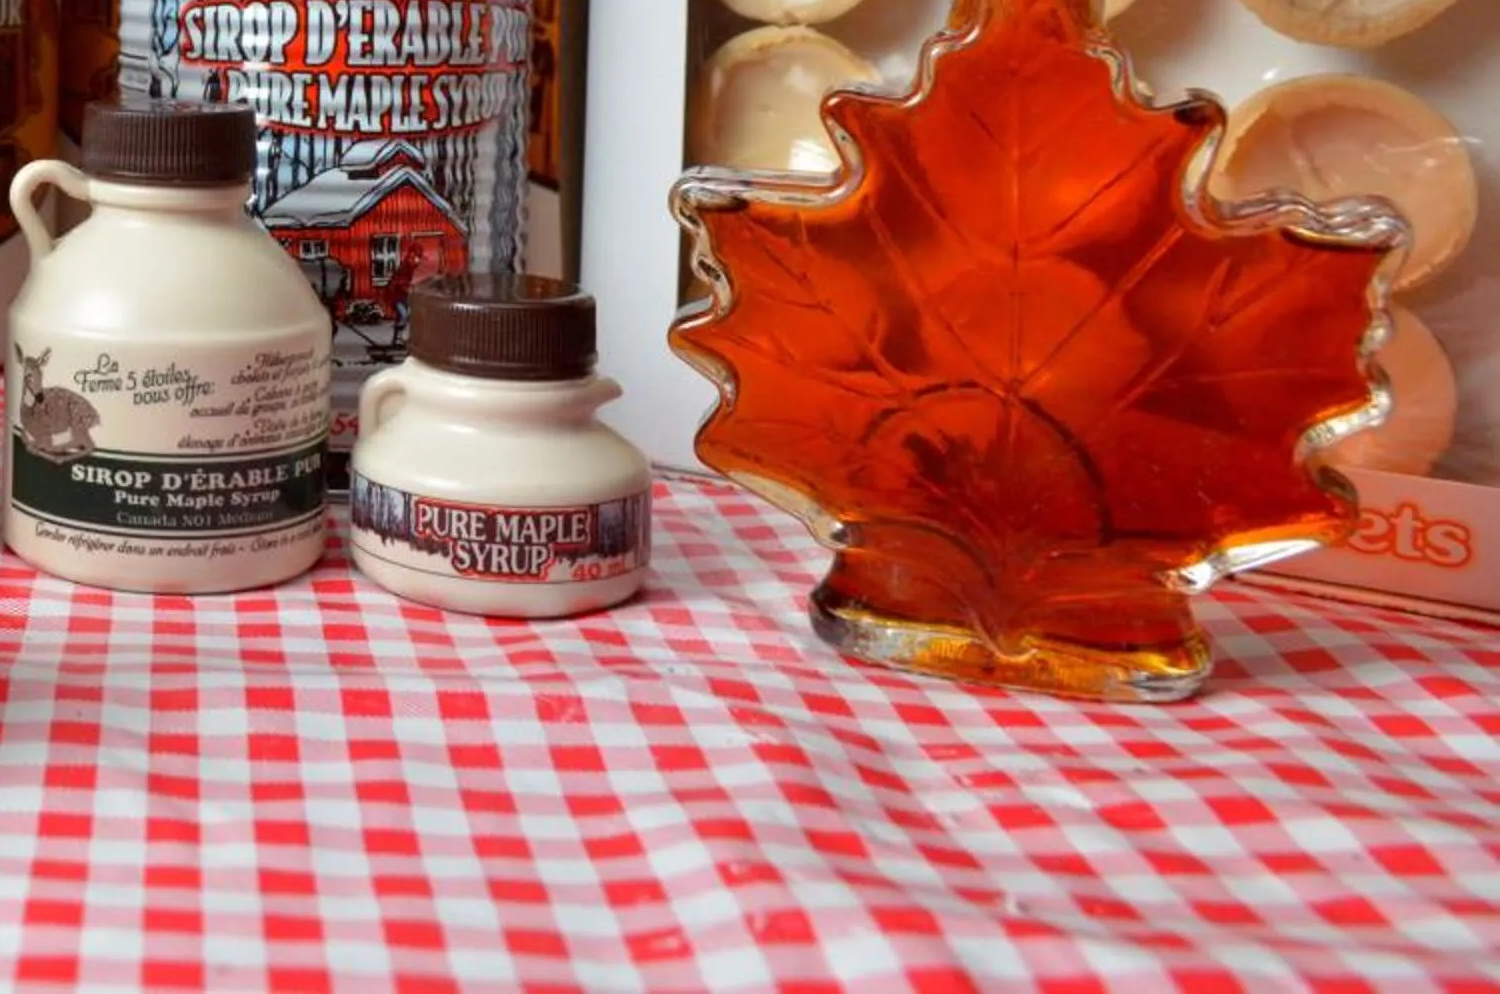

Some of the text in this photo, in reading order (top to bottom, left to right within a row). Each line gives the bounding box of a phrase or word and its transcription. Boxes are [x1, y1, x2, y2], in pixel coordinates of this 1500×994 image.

[184, 2, 297, 63] SIROP
[228, 70, 314, 124] PURE
[318, 73, 428, 133] MAPLE
[74, 362, 190, 394] Ferme 5 étoiles
[94, 353, 119, 376] La
[133, 389, 170, 406] vous
[71, 464, 151, 490] SIROP
[161, 464, 289, 491] D'ÉRABLE
[114, 488, 280, 510] Pure Maple Syrup
[116, 510, 177, 528] Canada
[417, 503, 587, 544] PURE MAPLE
[117, 540, 146, 555] dans
[148, 546, 164, 556] un
[454, 543, 549, 575] SYRUP
